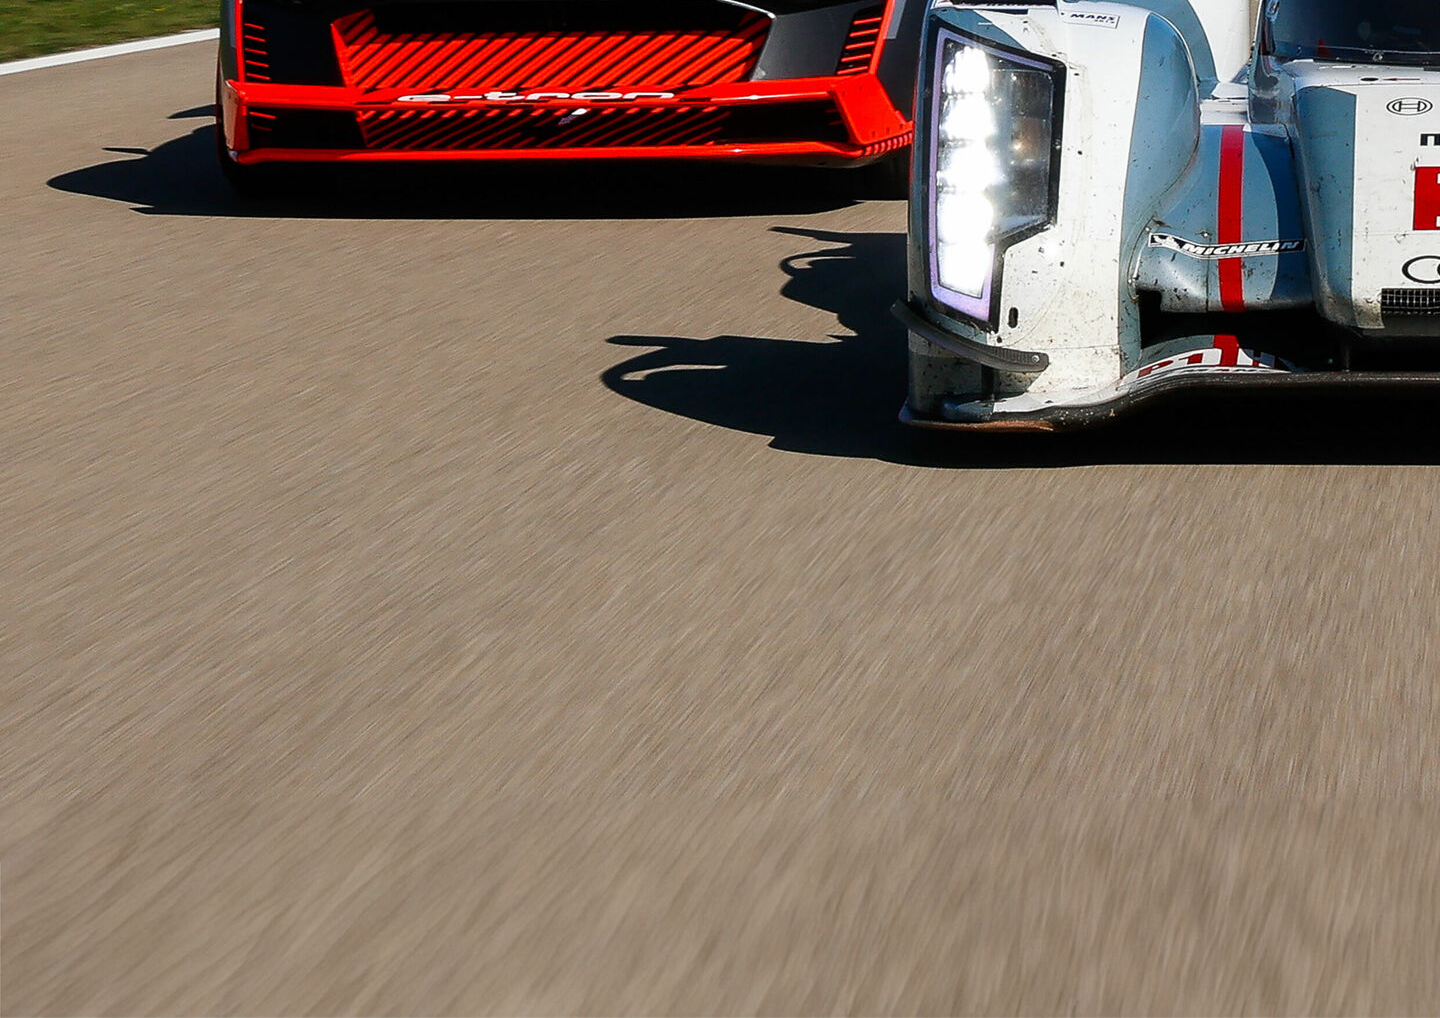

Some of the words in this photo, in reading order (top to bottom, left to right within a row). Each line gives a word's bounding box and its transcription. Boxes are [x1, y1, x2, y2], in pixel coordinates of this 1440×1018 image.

[397, 91, 675, 102] e-tron
[1179, 240, 1300, 256] MICHELIN
[1137, 352, 1204, 379] P1
